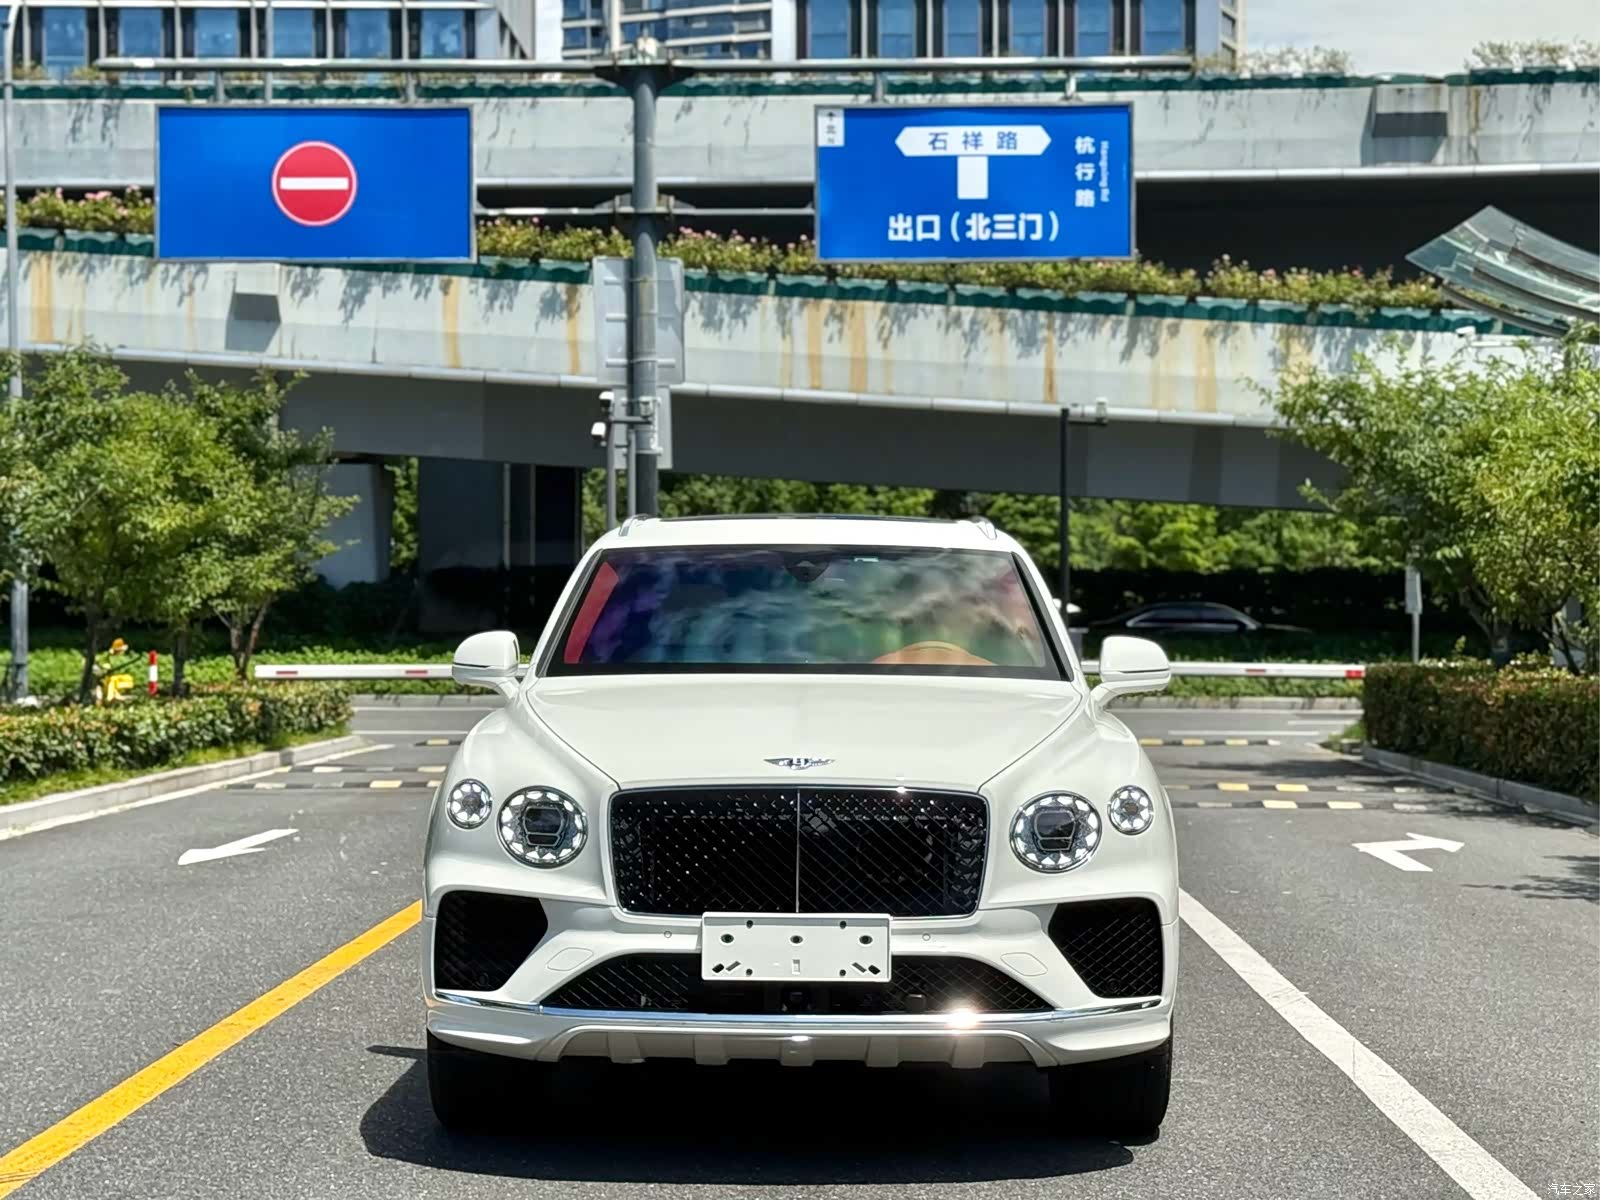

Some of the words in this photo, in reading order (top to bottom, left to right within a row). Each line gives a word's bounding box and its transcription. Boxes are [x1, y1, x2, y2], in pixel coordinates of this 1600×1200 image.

[928, 131, 1018, 151] 石祥路
[1075, 136, 1096, 208] 杭行路
